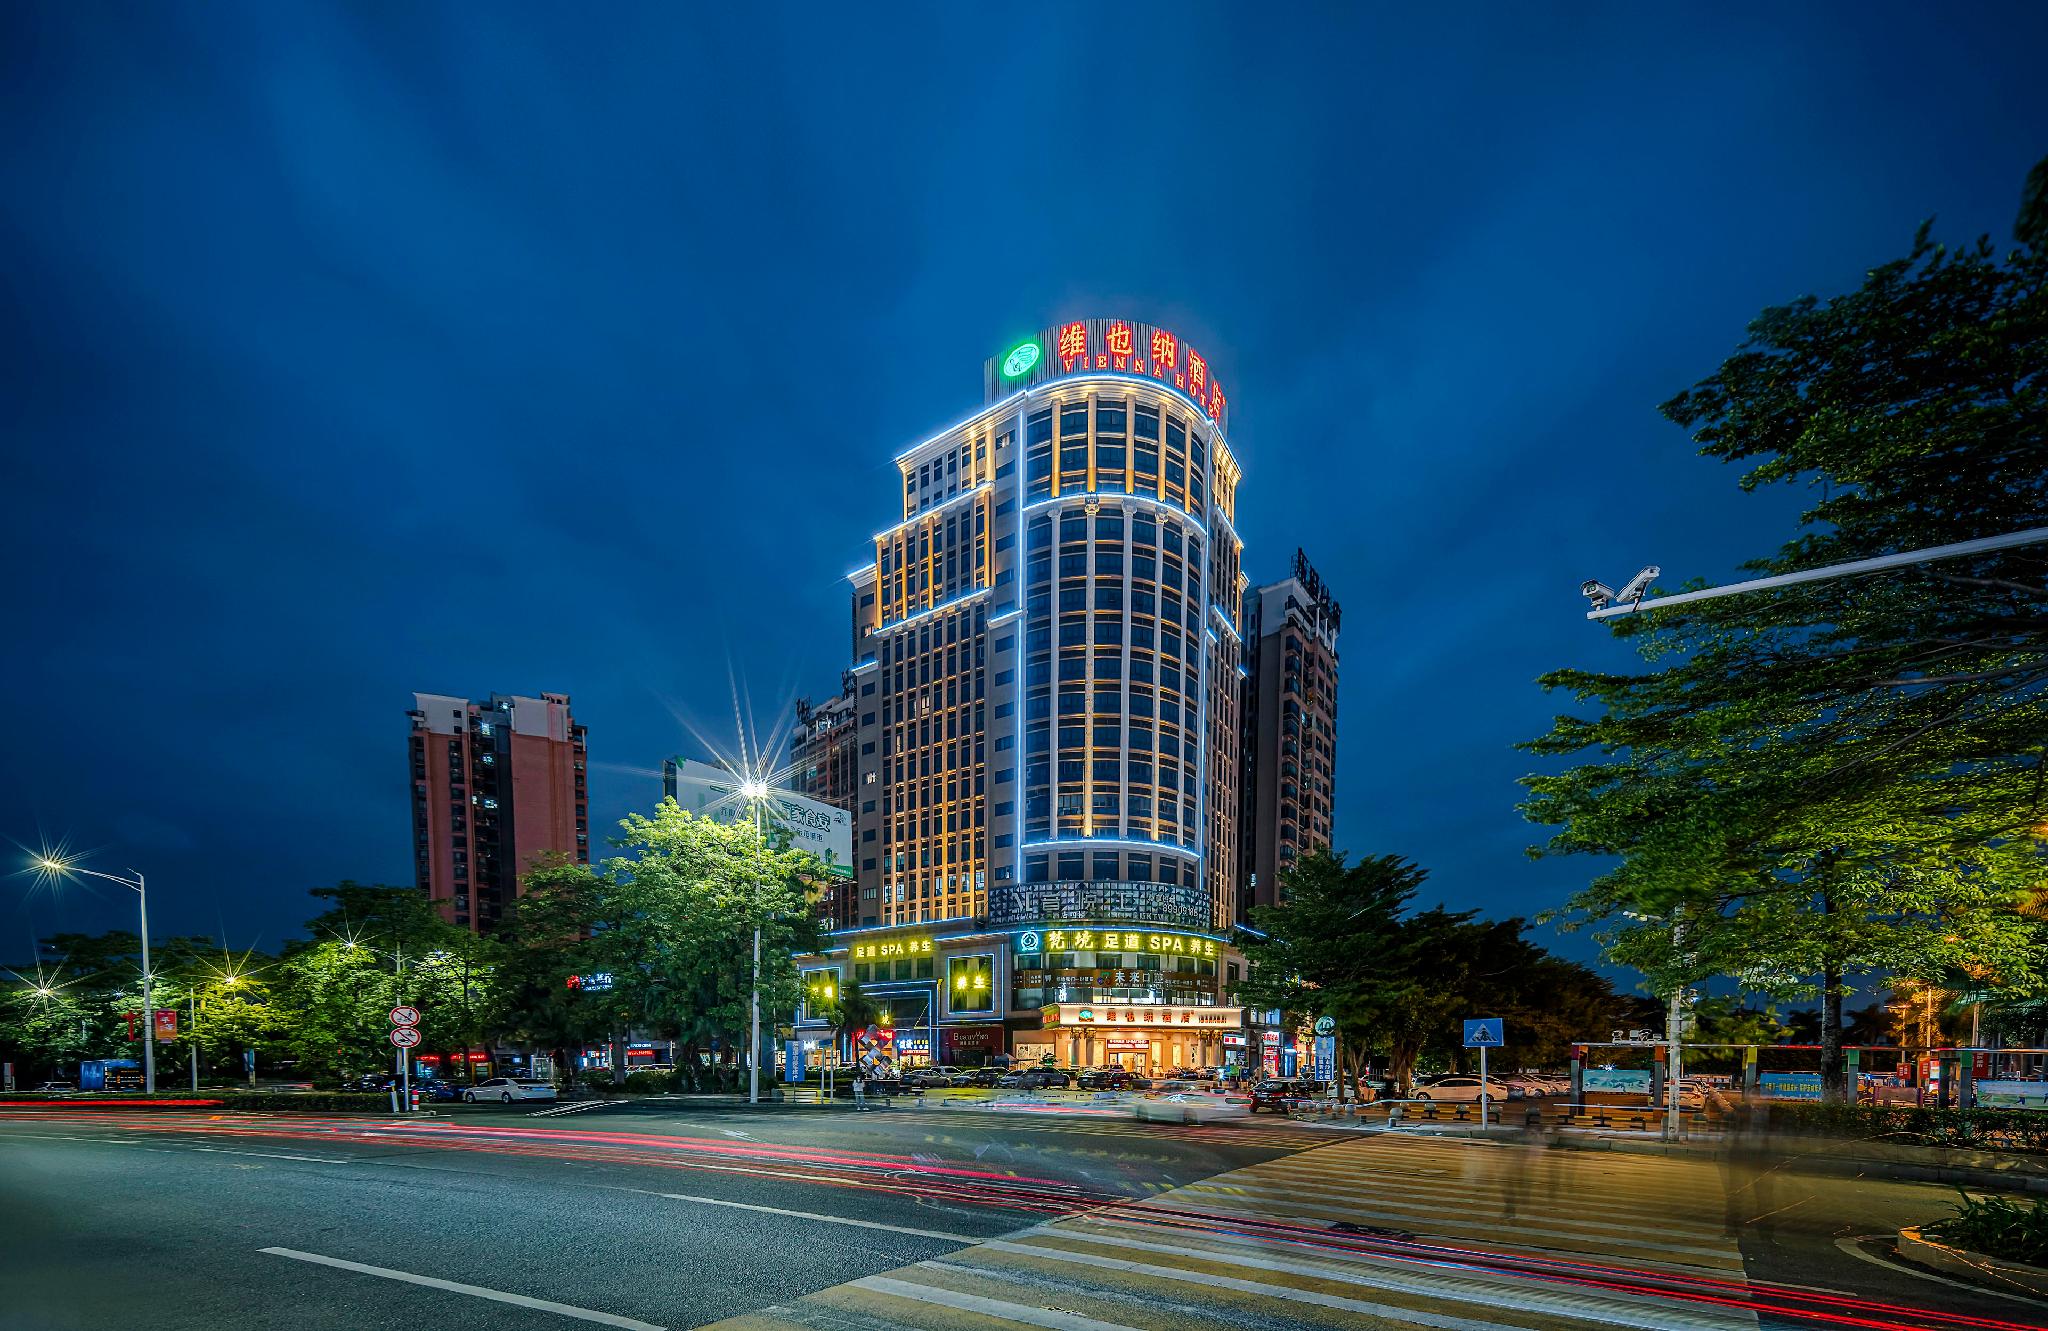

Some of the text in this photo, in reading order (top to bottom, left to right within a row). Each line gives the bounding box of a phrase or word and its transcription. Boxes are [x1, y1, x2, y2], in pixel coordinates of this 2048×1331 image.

[1060, 322, 1223, 417] 维也纳酒店
[1064, 355, 1162, 377] VIENNA
[856, 940, 931, 958] 足道 SPA 养生
[1150, 936, 1183, 951] SPA
[1190, 939, 1214, 956] 养生
